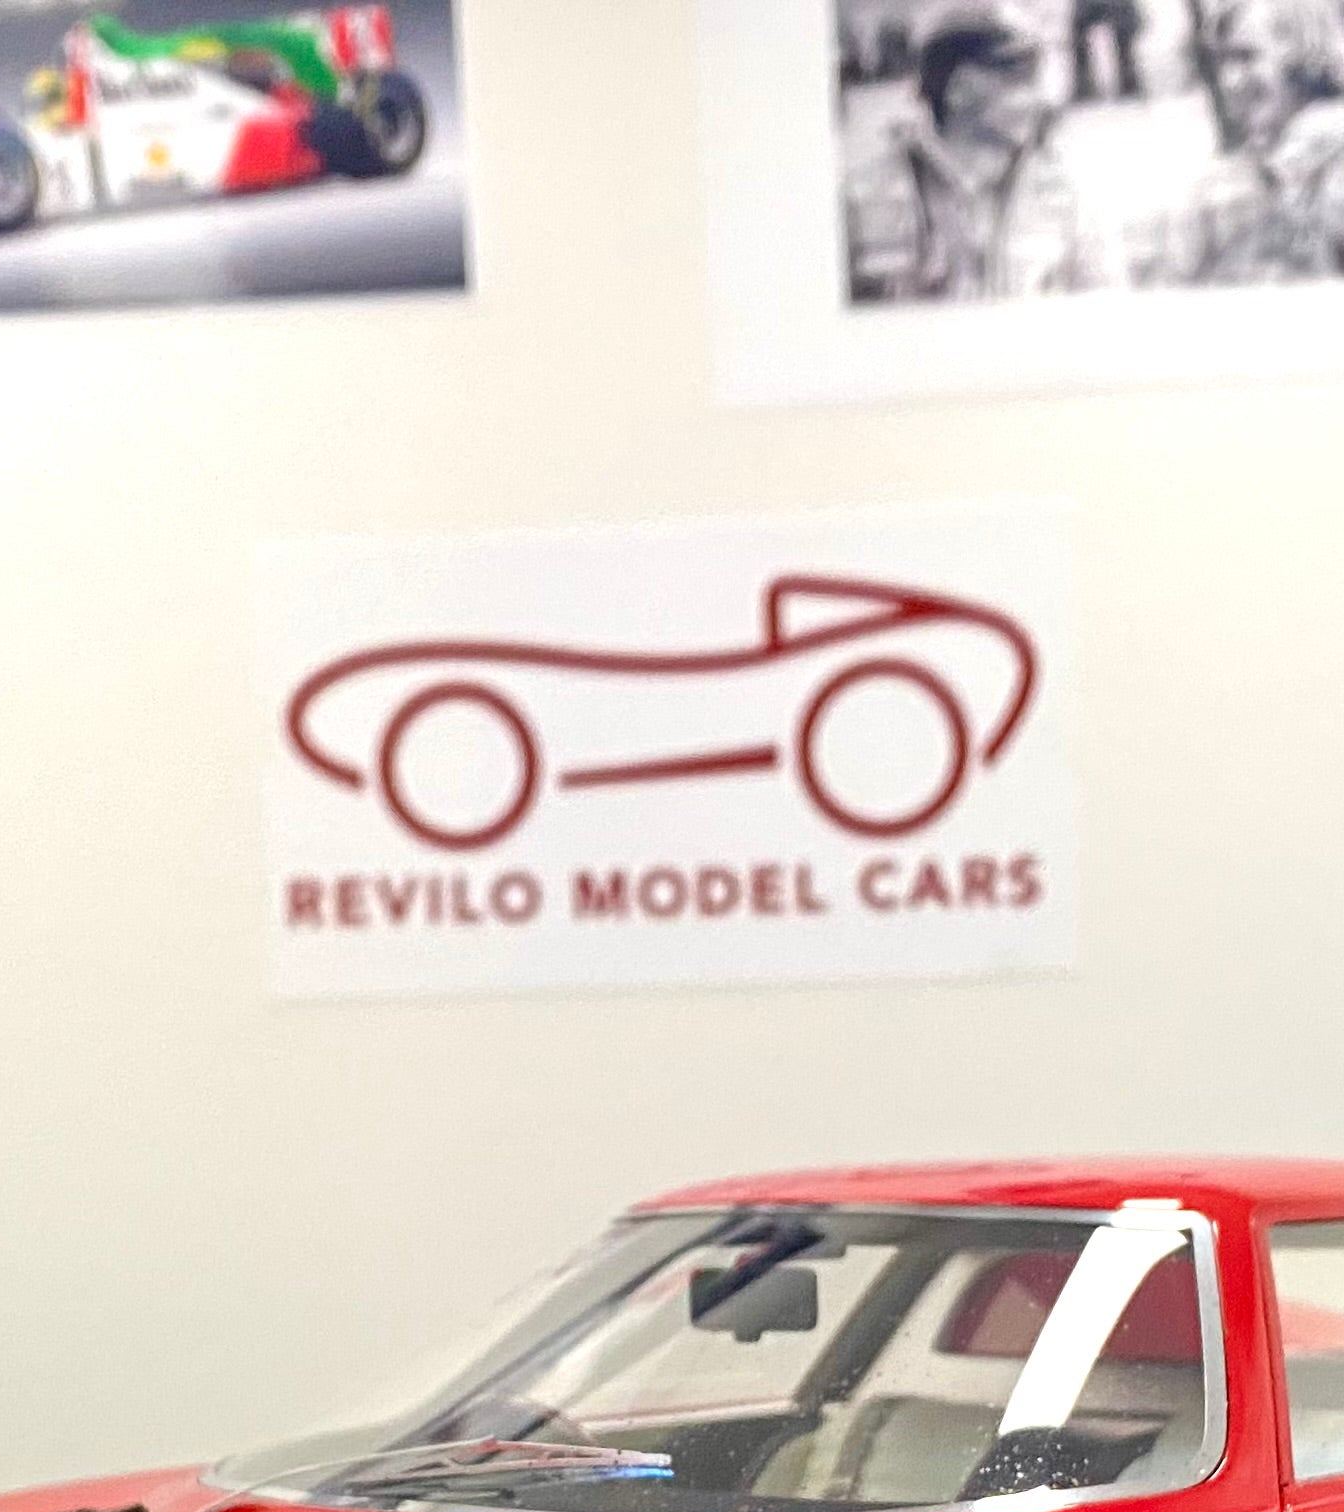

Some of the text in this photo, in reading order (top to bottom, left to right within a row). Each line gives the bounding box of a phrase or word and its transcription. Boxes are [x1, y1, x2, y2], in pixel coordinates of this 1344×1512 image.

[285, 852, 1046, 930] REVILO MODEL CARS
